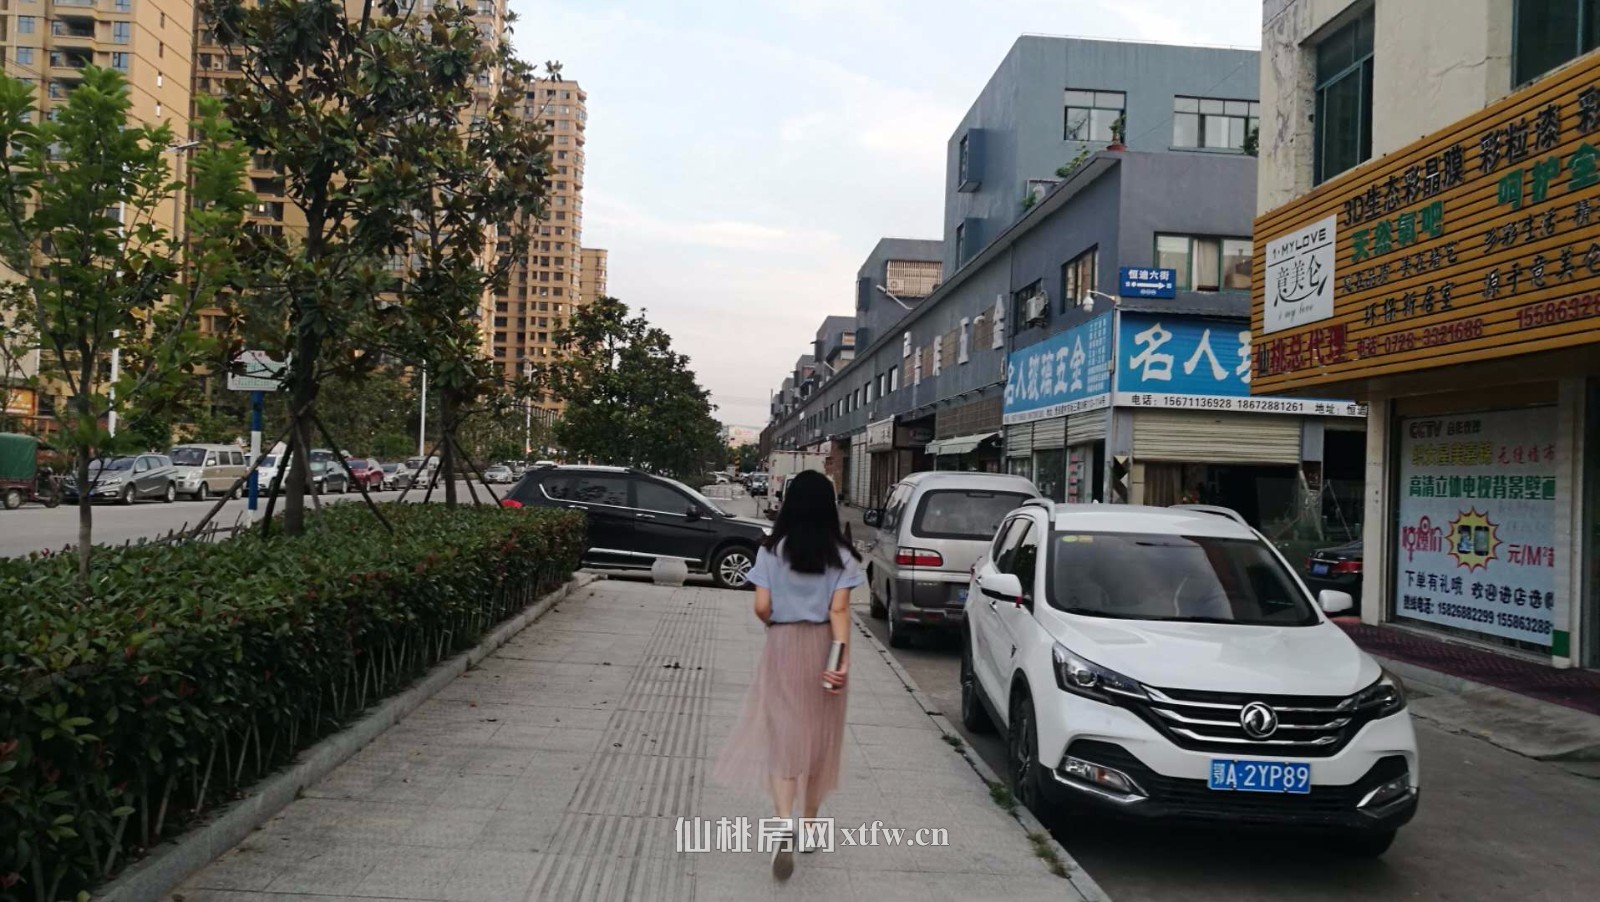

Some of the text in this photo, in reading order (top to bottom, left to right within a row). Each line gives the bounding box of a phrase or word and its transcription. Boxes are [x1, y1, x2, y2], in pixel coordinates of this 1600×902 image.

[1343, 144, 1465, 226] 3D生态彩晶膜
[1478, 103, 1561, 173] 彩粒漆
[1350, 200, 1445, 262] 天然氧吧
[1364, 281, 1457, 326] 环保新居室
[1257, 323, 1347, 376] 仙桃总代理
[1004, 334, 1086, 407] 名人玻璃五金
[1163, 396, 1231, 409] 15671136928
[1237, 399, 1304, 412] 18672881261
[1409, 420, 1443, 438] CCTV
[1408, 475, 1556, 500] 高清立体电视背景壁画
[1405, 570, 1464, 596] 下单有礼哦
[1438, 602, 1494, 624] 15826882299
